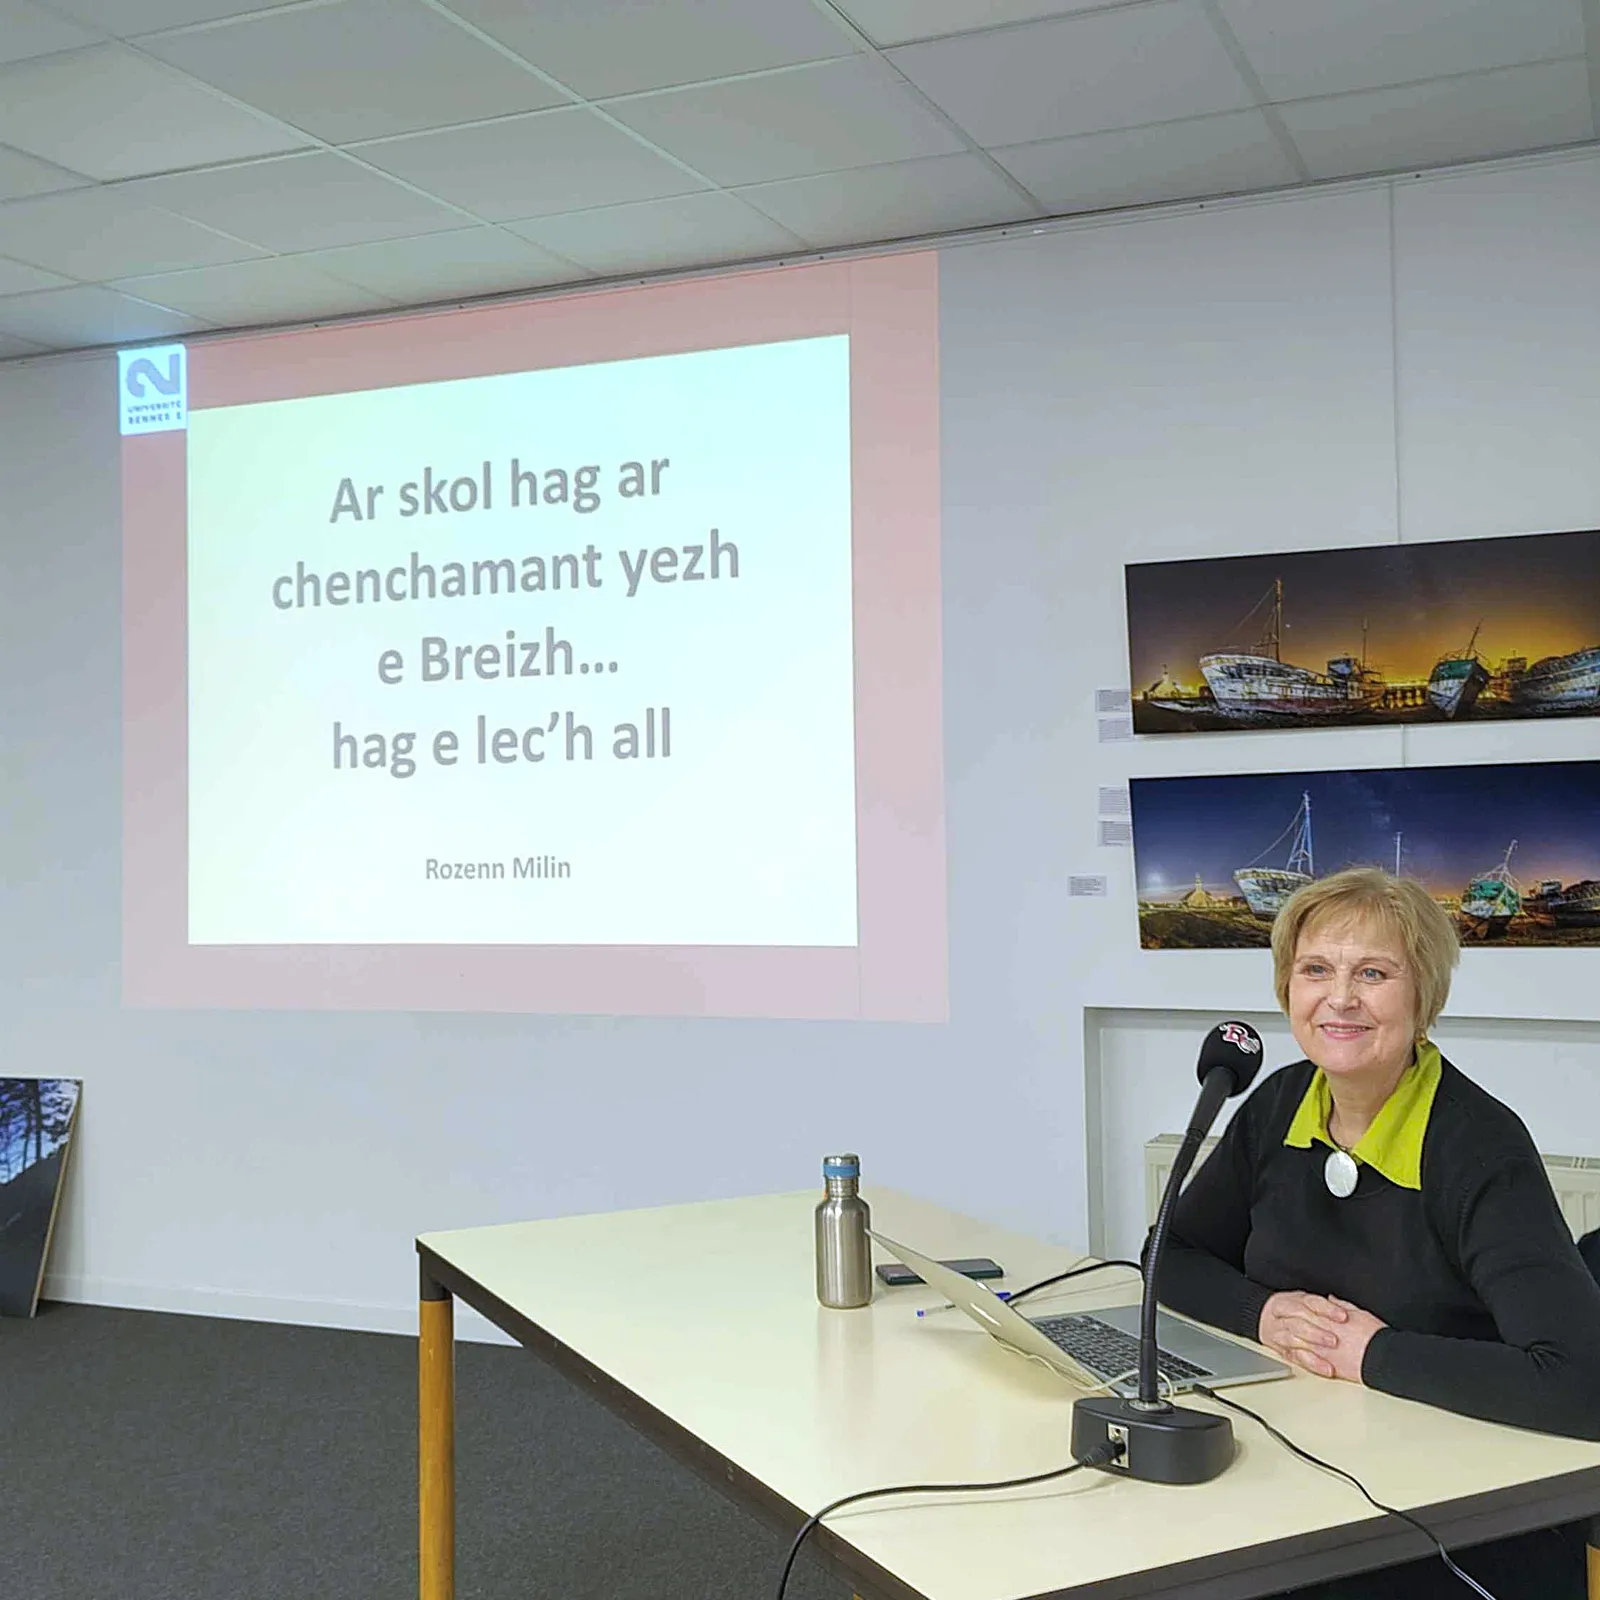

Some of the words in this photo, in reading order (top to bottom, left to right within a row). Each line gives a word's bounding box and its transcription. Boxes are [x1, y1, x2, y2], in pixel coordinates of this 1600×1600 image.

[329, 477, 385, 524] Ar
[399, 460, 492, 518] skol
[510, 457, 602, 515] hag
[617, 457, 670, 499] ar
[272, 544, 603, 610] chenchamant
[618, 527, 740, 598] yezh
[378, 649, 404, 685] e
[421, 625, 619, 682] Breizh...
[333, 721, 417, 779] hag
[432, 730, 459, 766] e
[477, 710, 593, 765] lec’h
[612, 706, 671, 760] all
[425, 858, 505, 880] Rozenn
[513, 855, 571, 879] Milin
